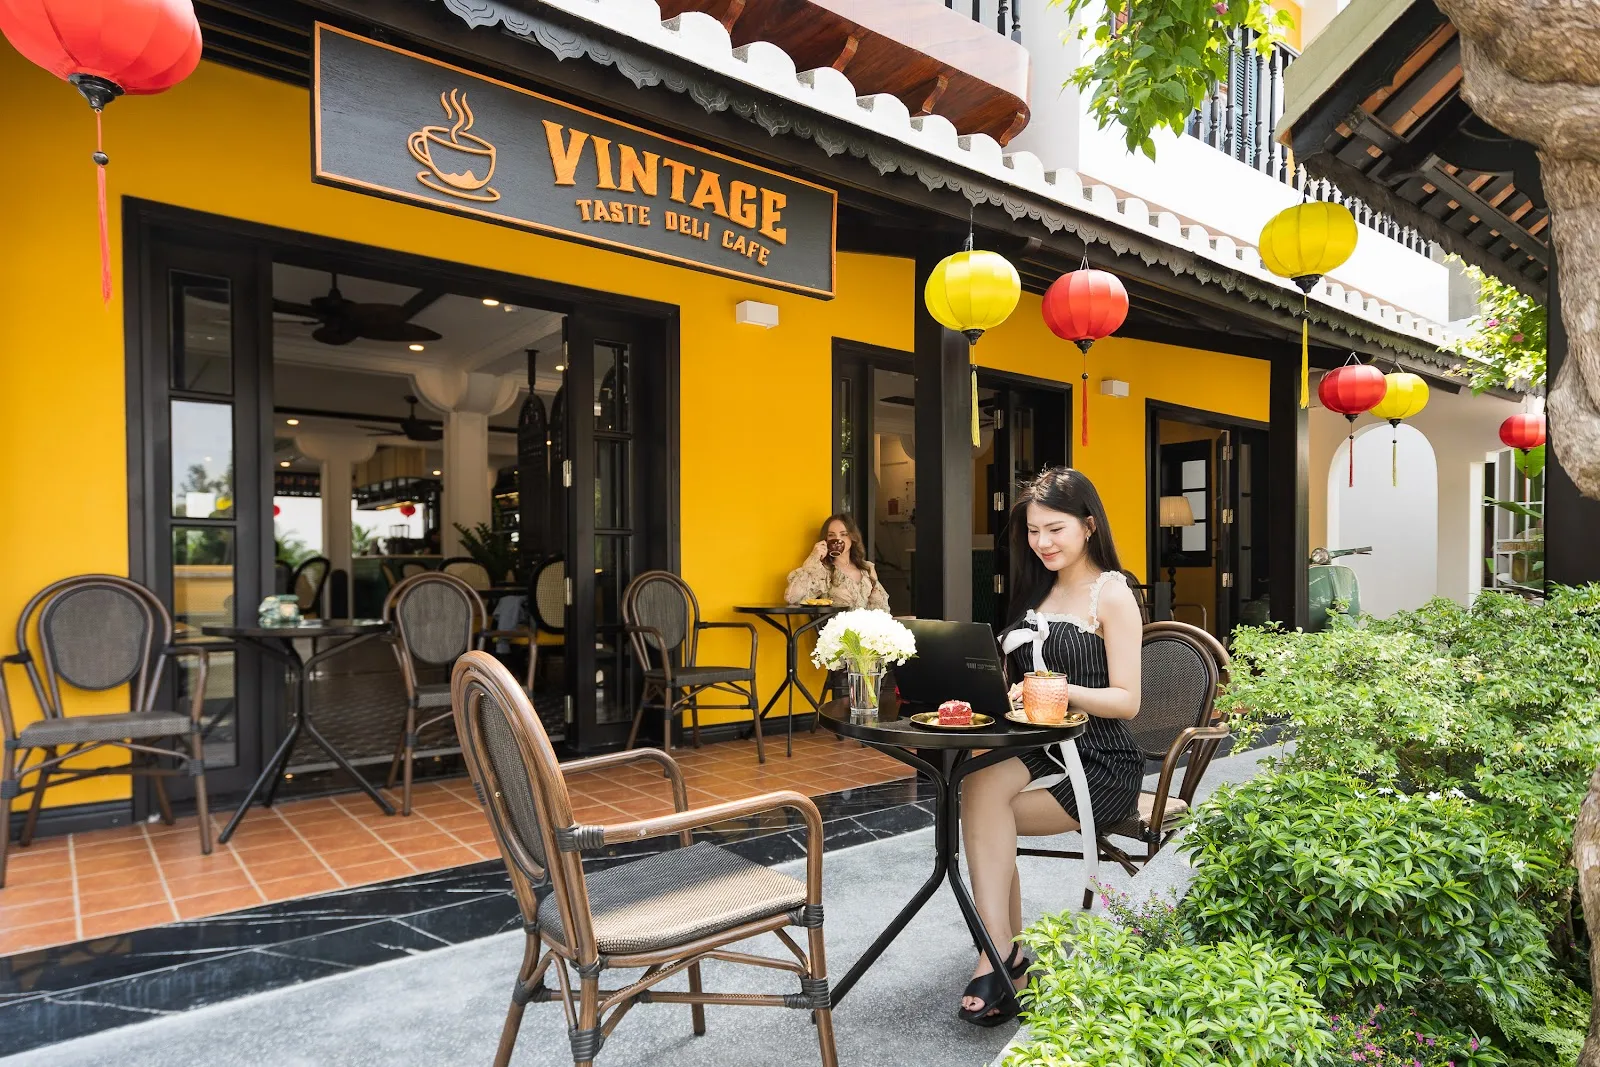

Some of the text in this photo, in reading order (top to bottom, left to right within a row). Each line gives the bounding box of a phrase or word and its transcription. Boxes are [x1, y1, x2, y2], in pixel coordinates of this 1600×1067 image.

[542, 119, 787, 245] VINTAGE
[575, 199, 771, 267] TASTE DELI CAFE
